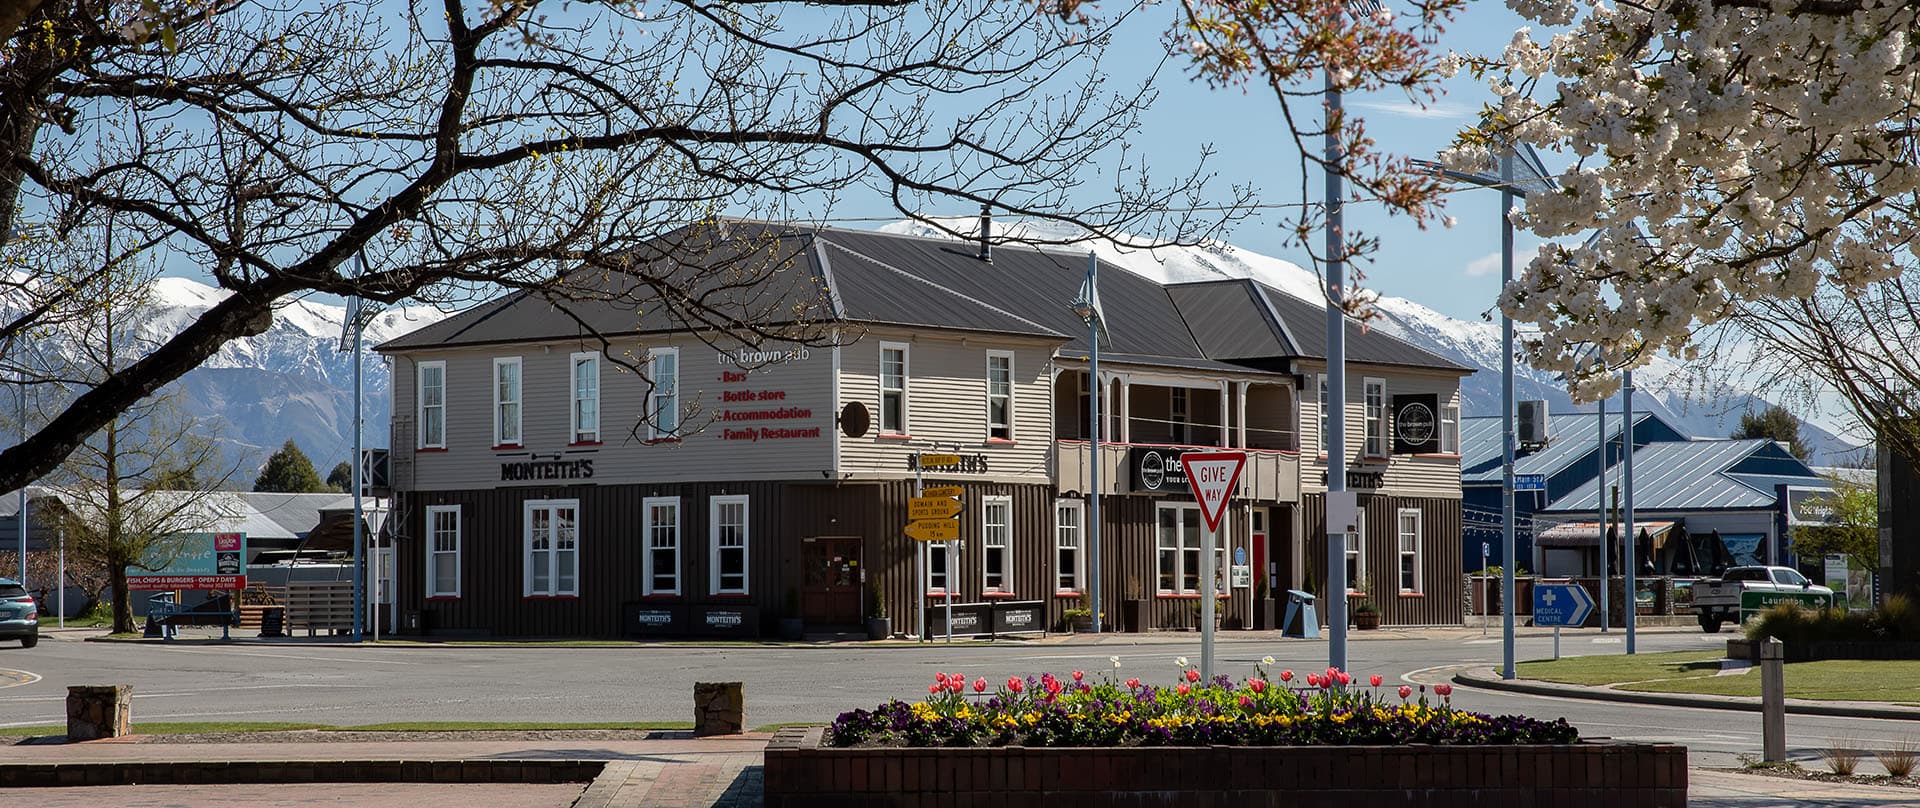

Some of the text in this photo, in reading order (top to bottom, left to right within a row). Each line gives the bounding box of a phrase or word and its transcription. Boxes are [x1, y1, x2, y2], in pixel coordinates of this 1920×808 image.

[740, 348, 781, 363] brown
[723, 371, 746, 383] Bars
[723, 389, 786, 402] Bottle store
[723, 407, 812, 422] Accommodation
[723, 426, 820, 442] Family Restaurant
[501, 459, 594, 481] MONTEITH'S
[1165, 456, 1182, 472] the
[1200, 466, 1227, 483] GIVE
[1205, 488, 1221, 501] WAY
[918, 522, 940, 530] PUDDING
[950, 616, 977, 625] ONTEITH'S
